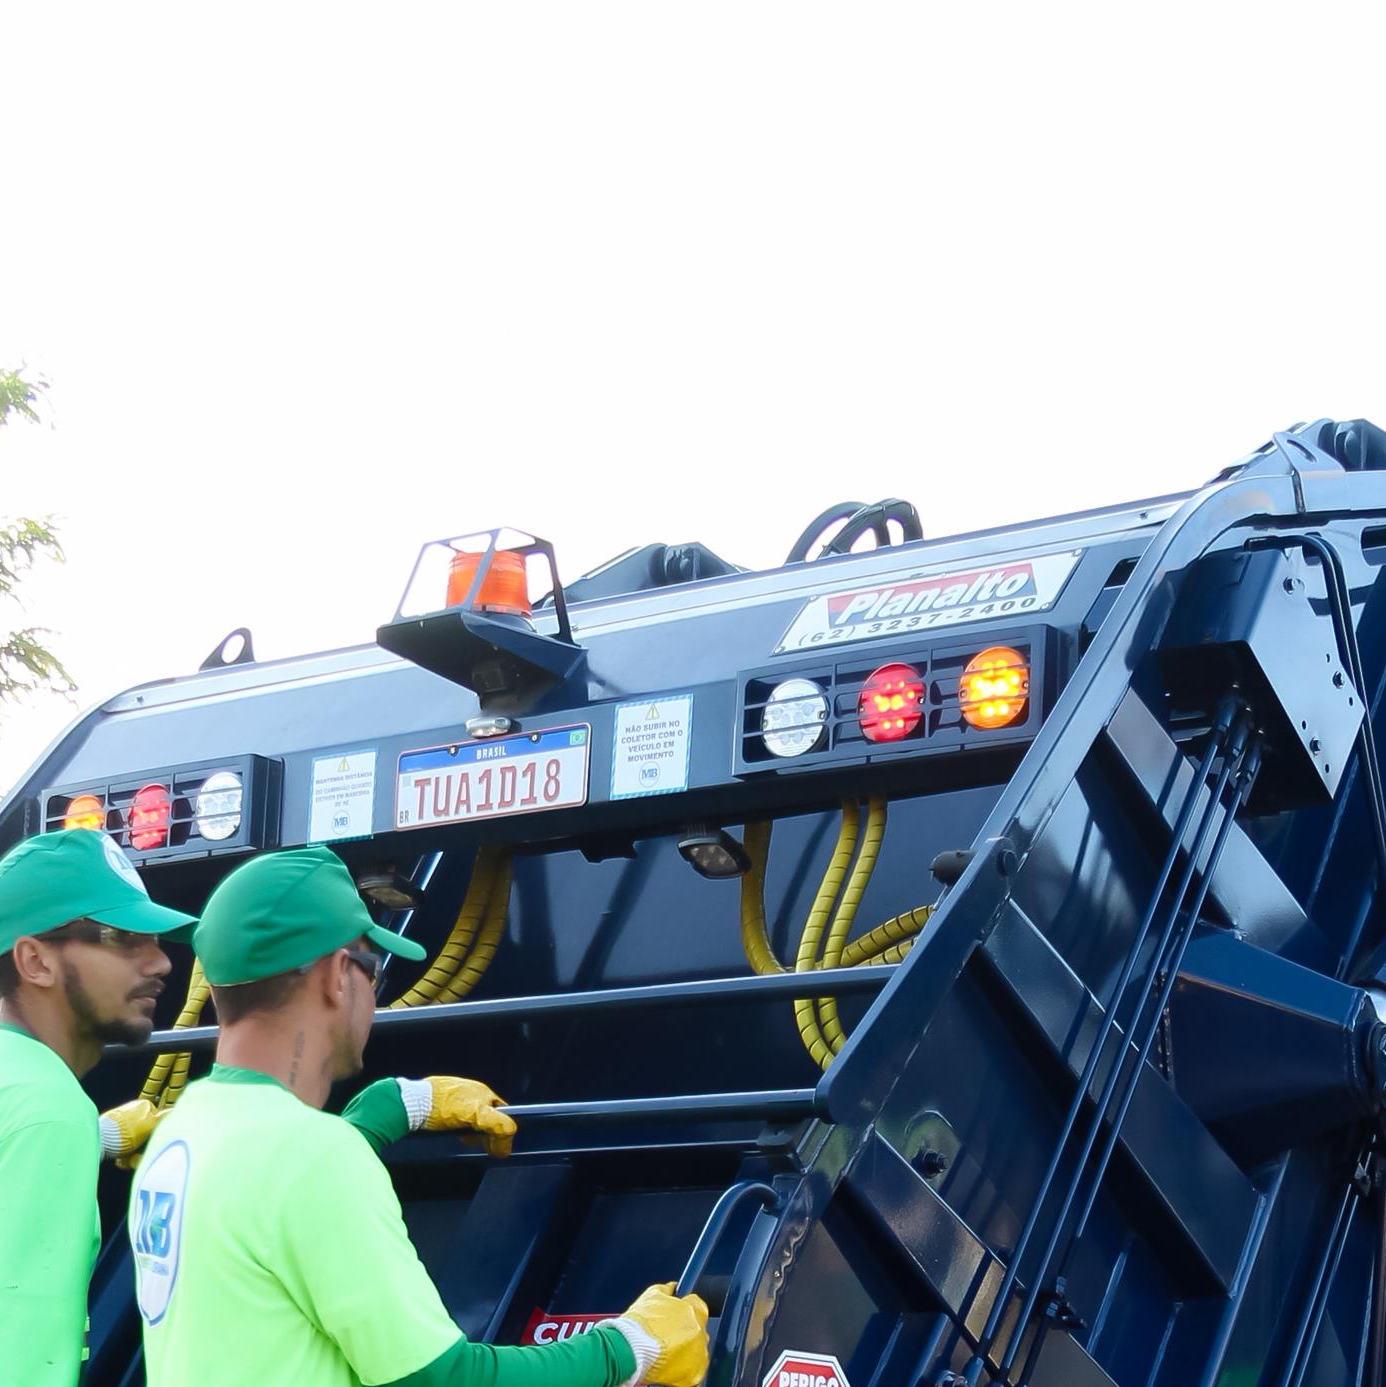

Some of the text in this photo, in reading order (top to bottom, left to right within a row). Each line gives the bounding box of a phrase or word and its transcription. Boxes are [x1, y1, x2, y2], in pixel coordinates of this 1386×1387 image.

[835, 569, 1031, 625] Planalto
[799, 598, 1035, 646] (62) 3237-2400
[625, 725, 642, 733] NÃO
[643, 722, 666, 731] SUBIR
[621, 734, 656, 744] COLETOR
[658, 730, 675, 738] COM
[476, 745, 507, 759] BRASIL
[628, 751, 674, 762] MOVIMENTO
[414, 758, 562, 820] TUA1D18
[399, 810, 410, 823] BR
